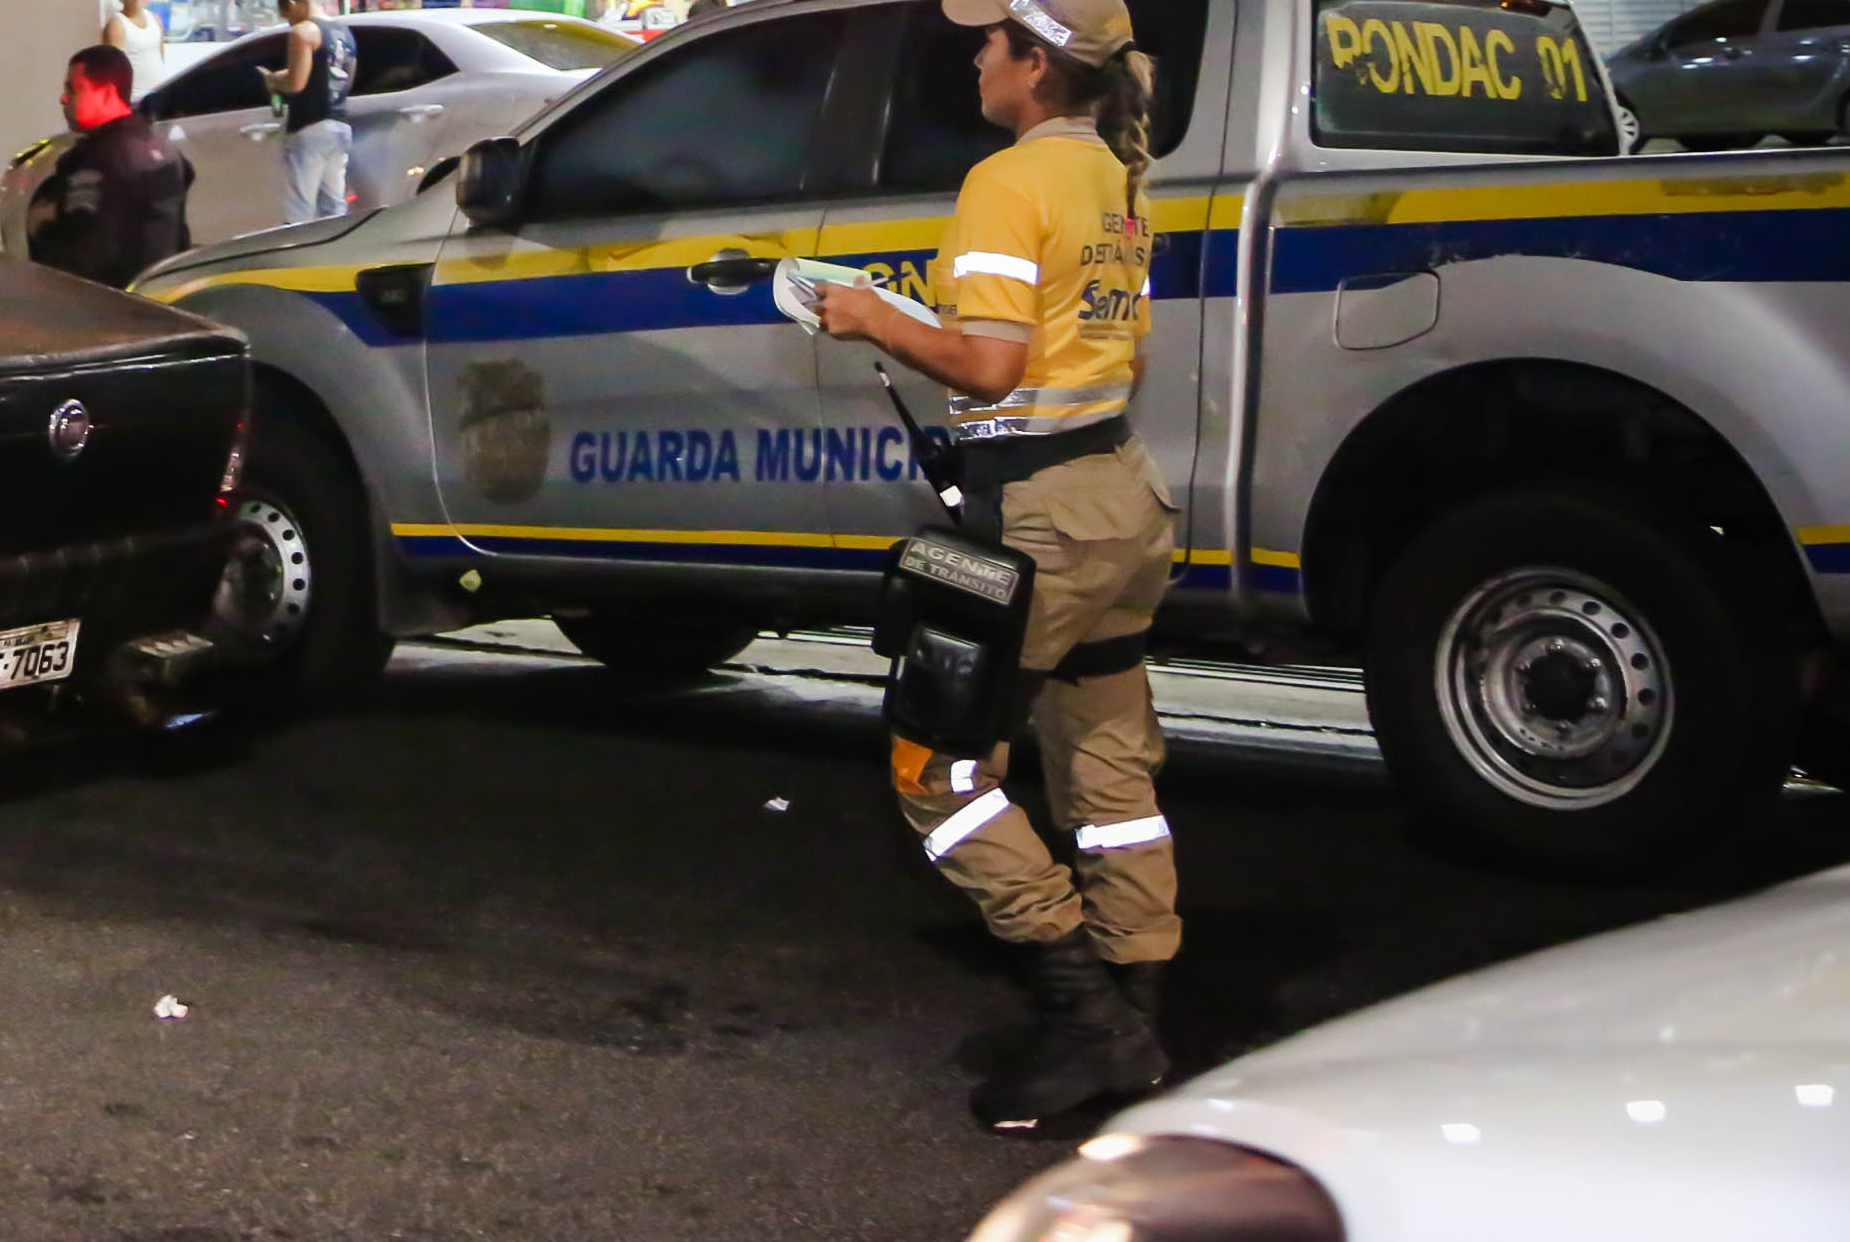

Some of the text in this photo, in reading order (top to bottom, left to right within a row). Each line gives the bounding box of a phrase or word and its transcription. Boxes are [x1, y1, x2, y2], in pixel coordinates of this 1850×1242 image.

[1536, 36, 1588, 102] 01
[570, 428, 742, 483] GUARDA
[904, 555, 926, 571] DE
[910, 541, 1014, 587] AGENTE
